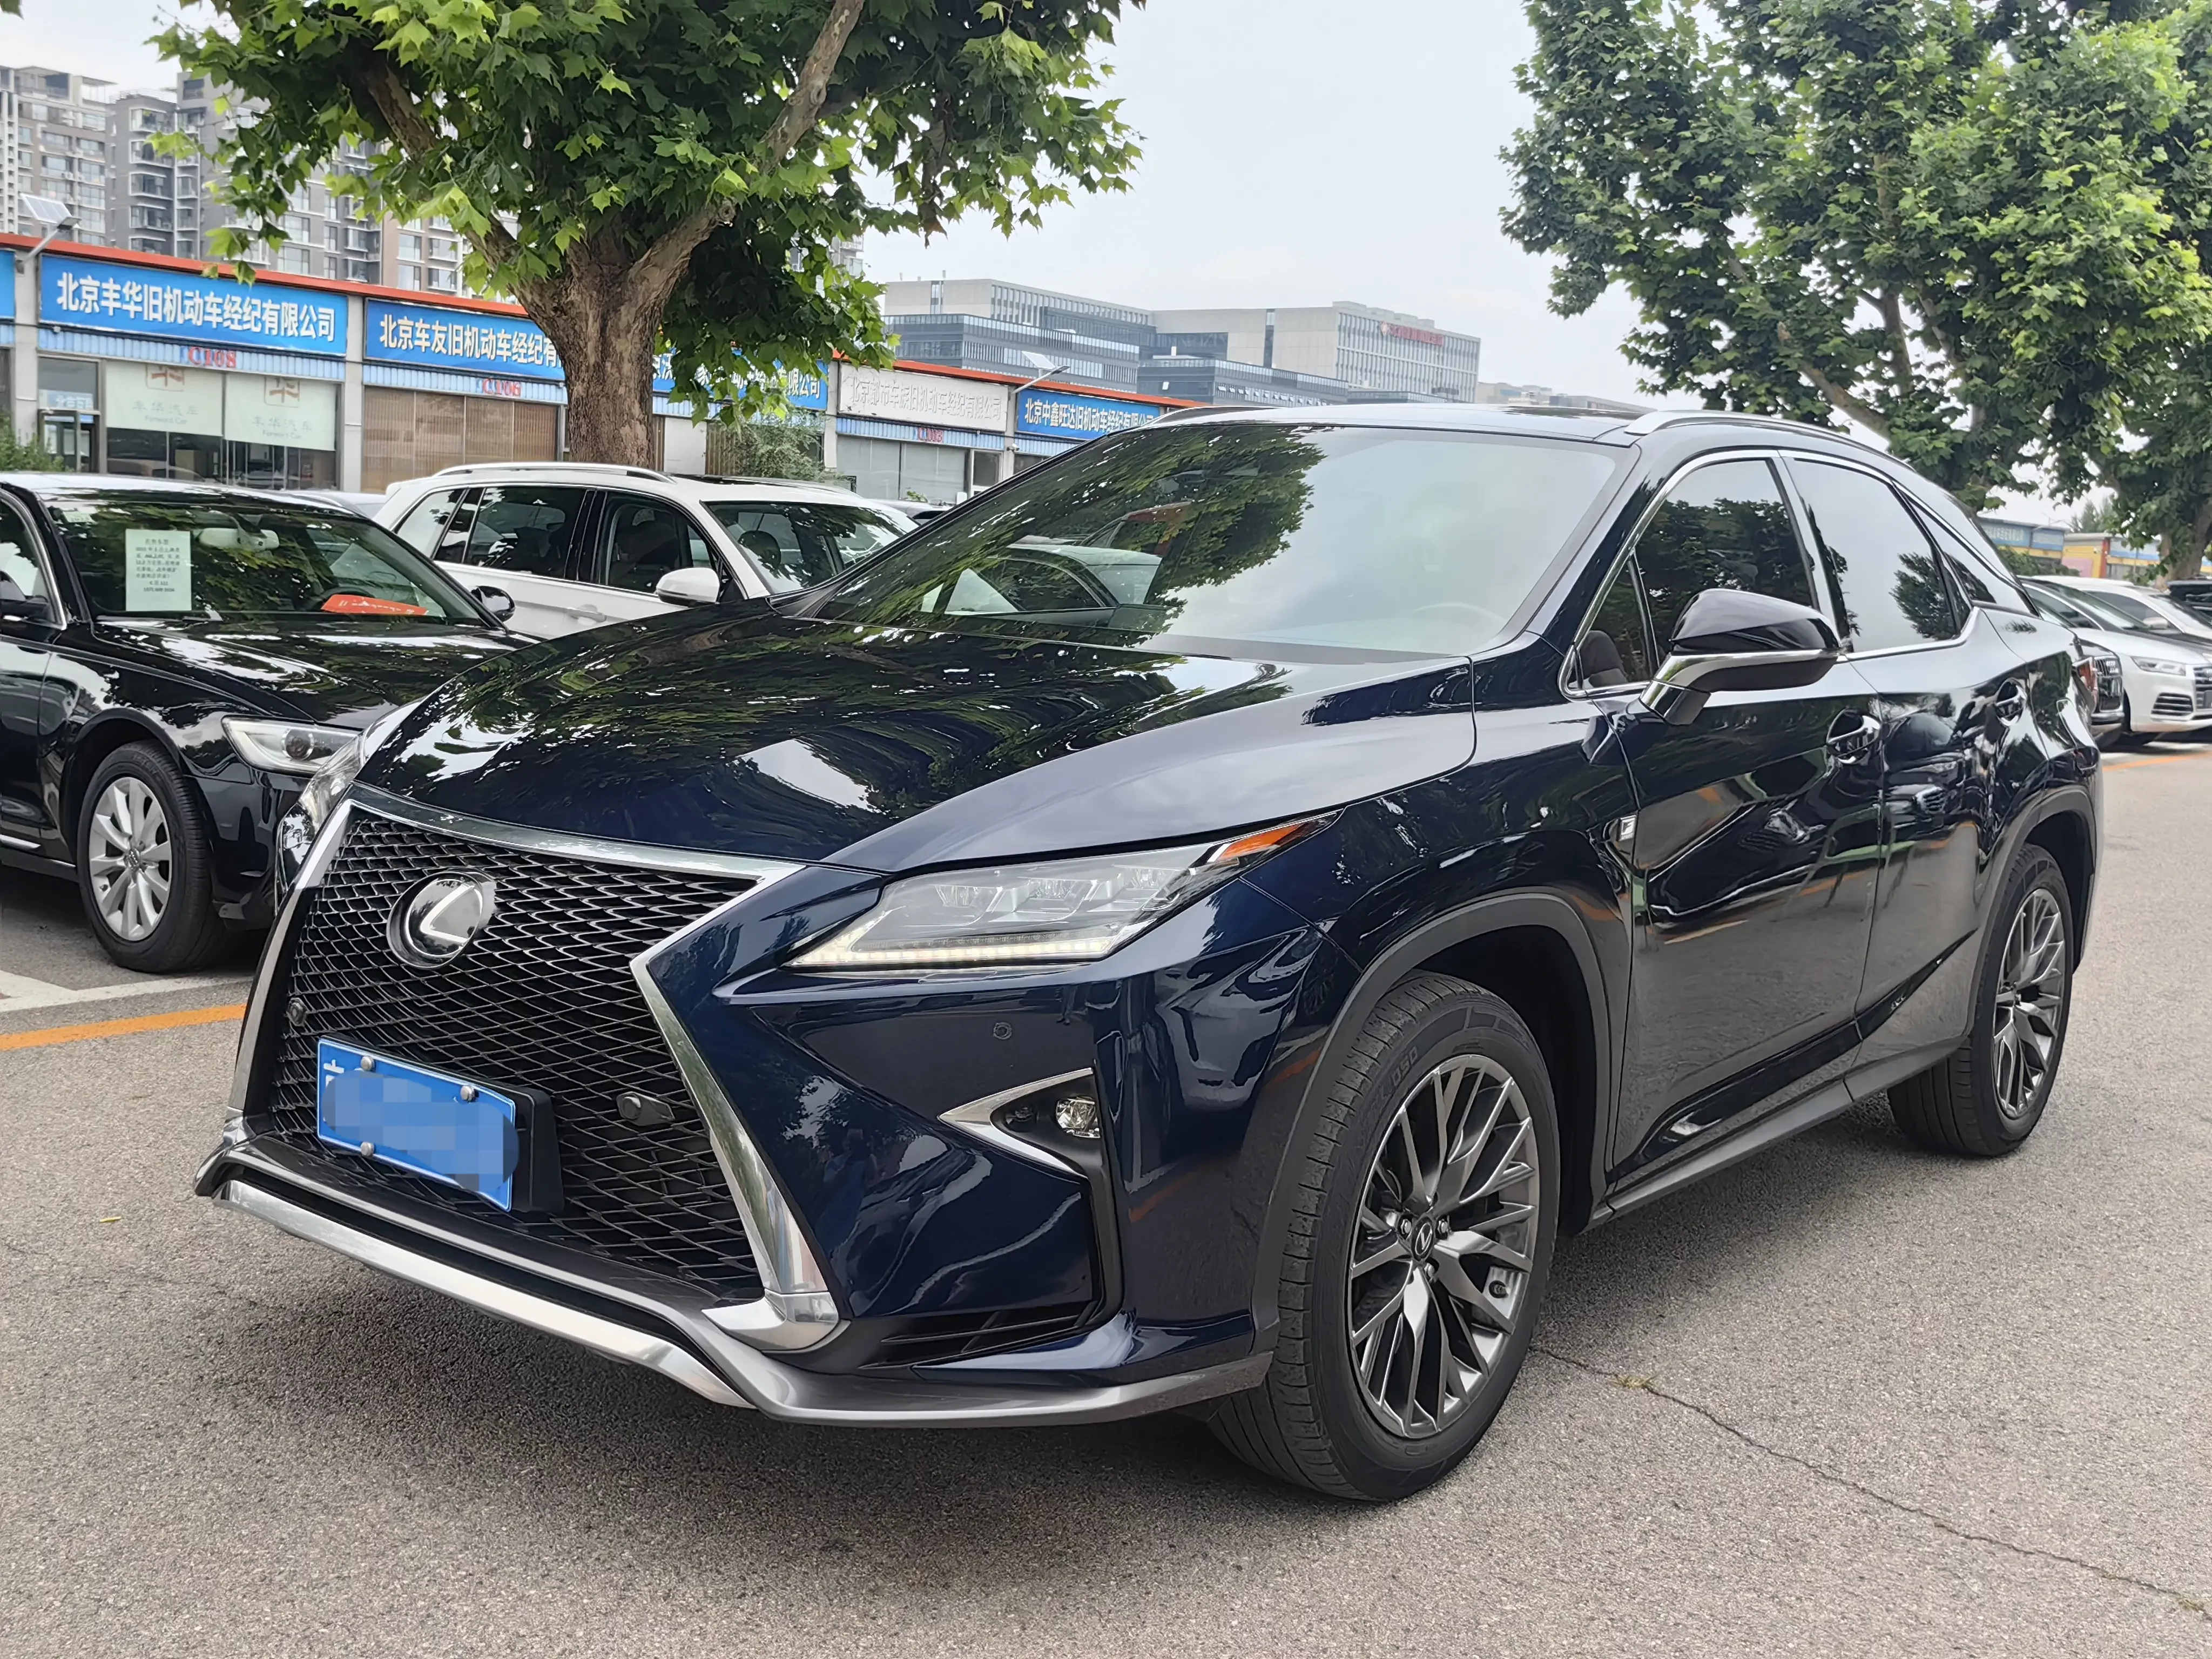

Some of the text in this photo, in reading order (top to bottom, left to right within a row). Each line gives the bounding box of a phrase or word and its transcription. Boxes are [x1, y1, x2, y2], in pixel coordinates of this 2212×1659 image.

[56, 272, 335, 342] 北京丰华旧机动车经纪有限公司
[188, 346, 237, 368] C108
[380, 314, 564, 368] 北京车友旧机动车经纪有
